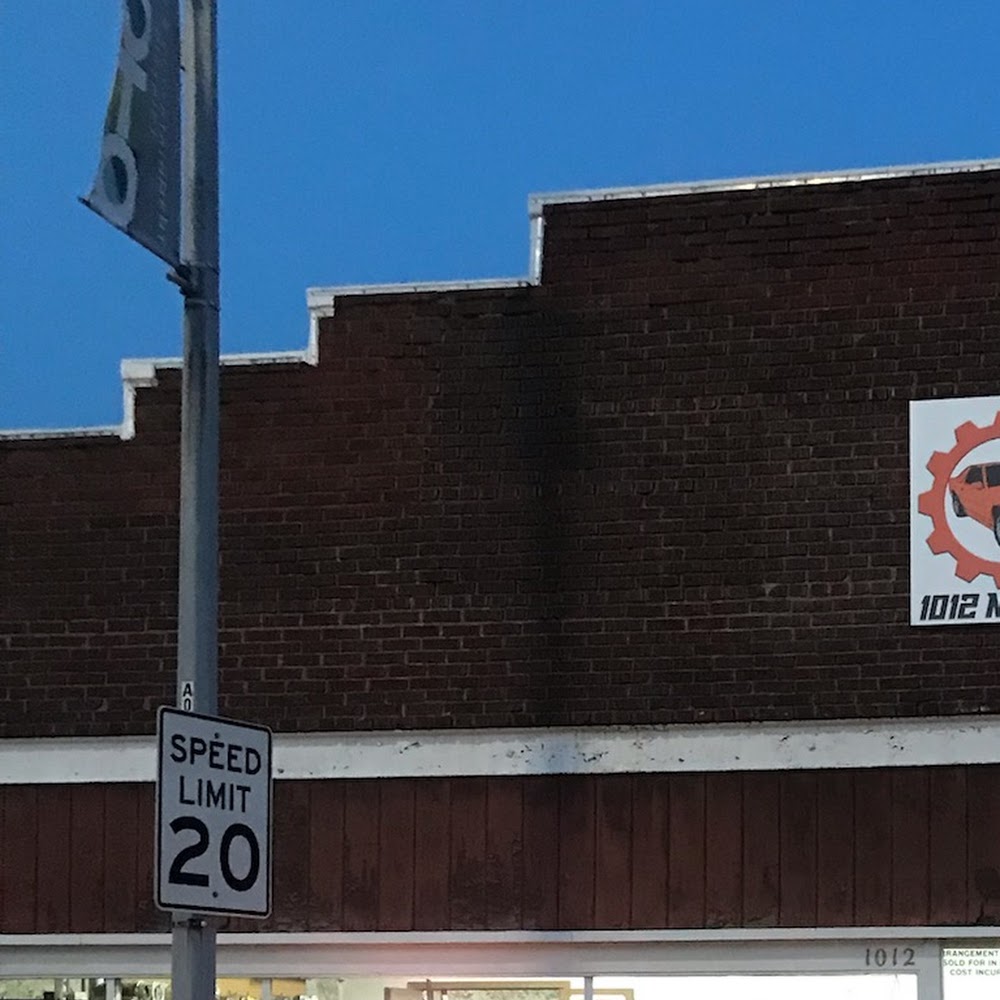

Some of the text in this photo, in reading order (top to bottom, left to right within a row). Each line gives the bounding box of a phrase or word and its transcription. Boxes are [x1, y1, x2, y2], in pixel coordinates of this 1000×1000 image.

[920, 594, 980, 620] 1012
[170, 733, 261, 775] SPEED
[179, 776, 251, 812] LIMIT
[168, 816, 260, 892] 20
[865, 947, 916, 967] 1012
